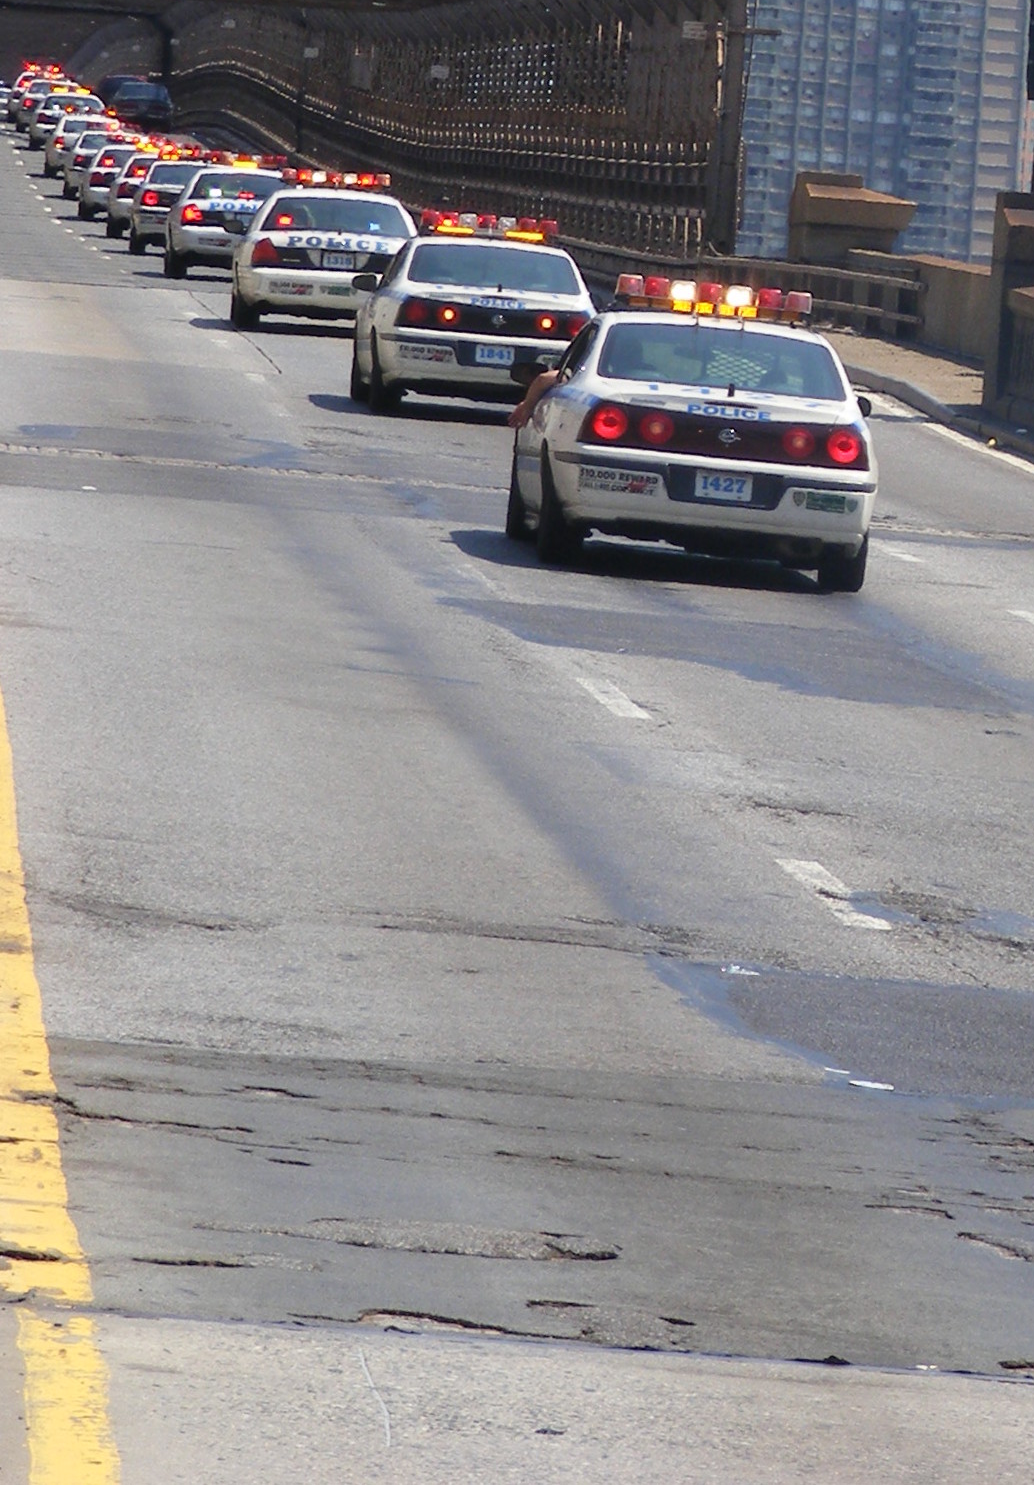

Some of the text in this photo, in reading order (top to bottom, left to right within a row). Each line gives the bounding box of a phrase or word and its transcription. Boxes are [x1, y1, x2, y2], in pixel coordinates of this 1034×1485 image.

[285, 236, 390, 253] POLICE
[470, 297, 526, 310] POLICE
[478, 347, 512, 360] 1841
[687, 403, 772, 422] POLICE
[702, 475, 748, 494] 1427
